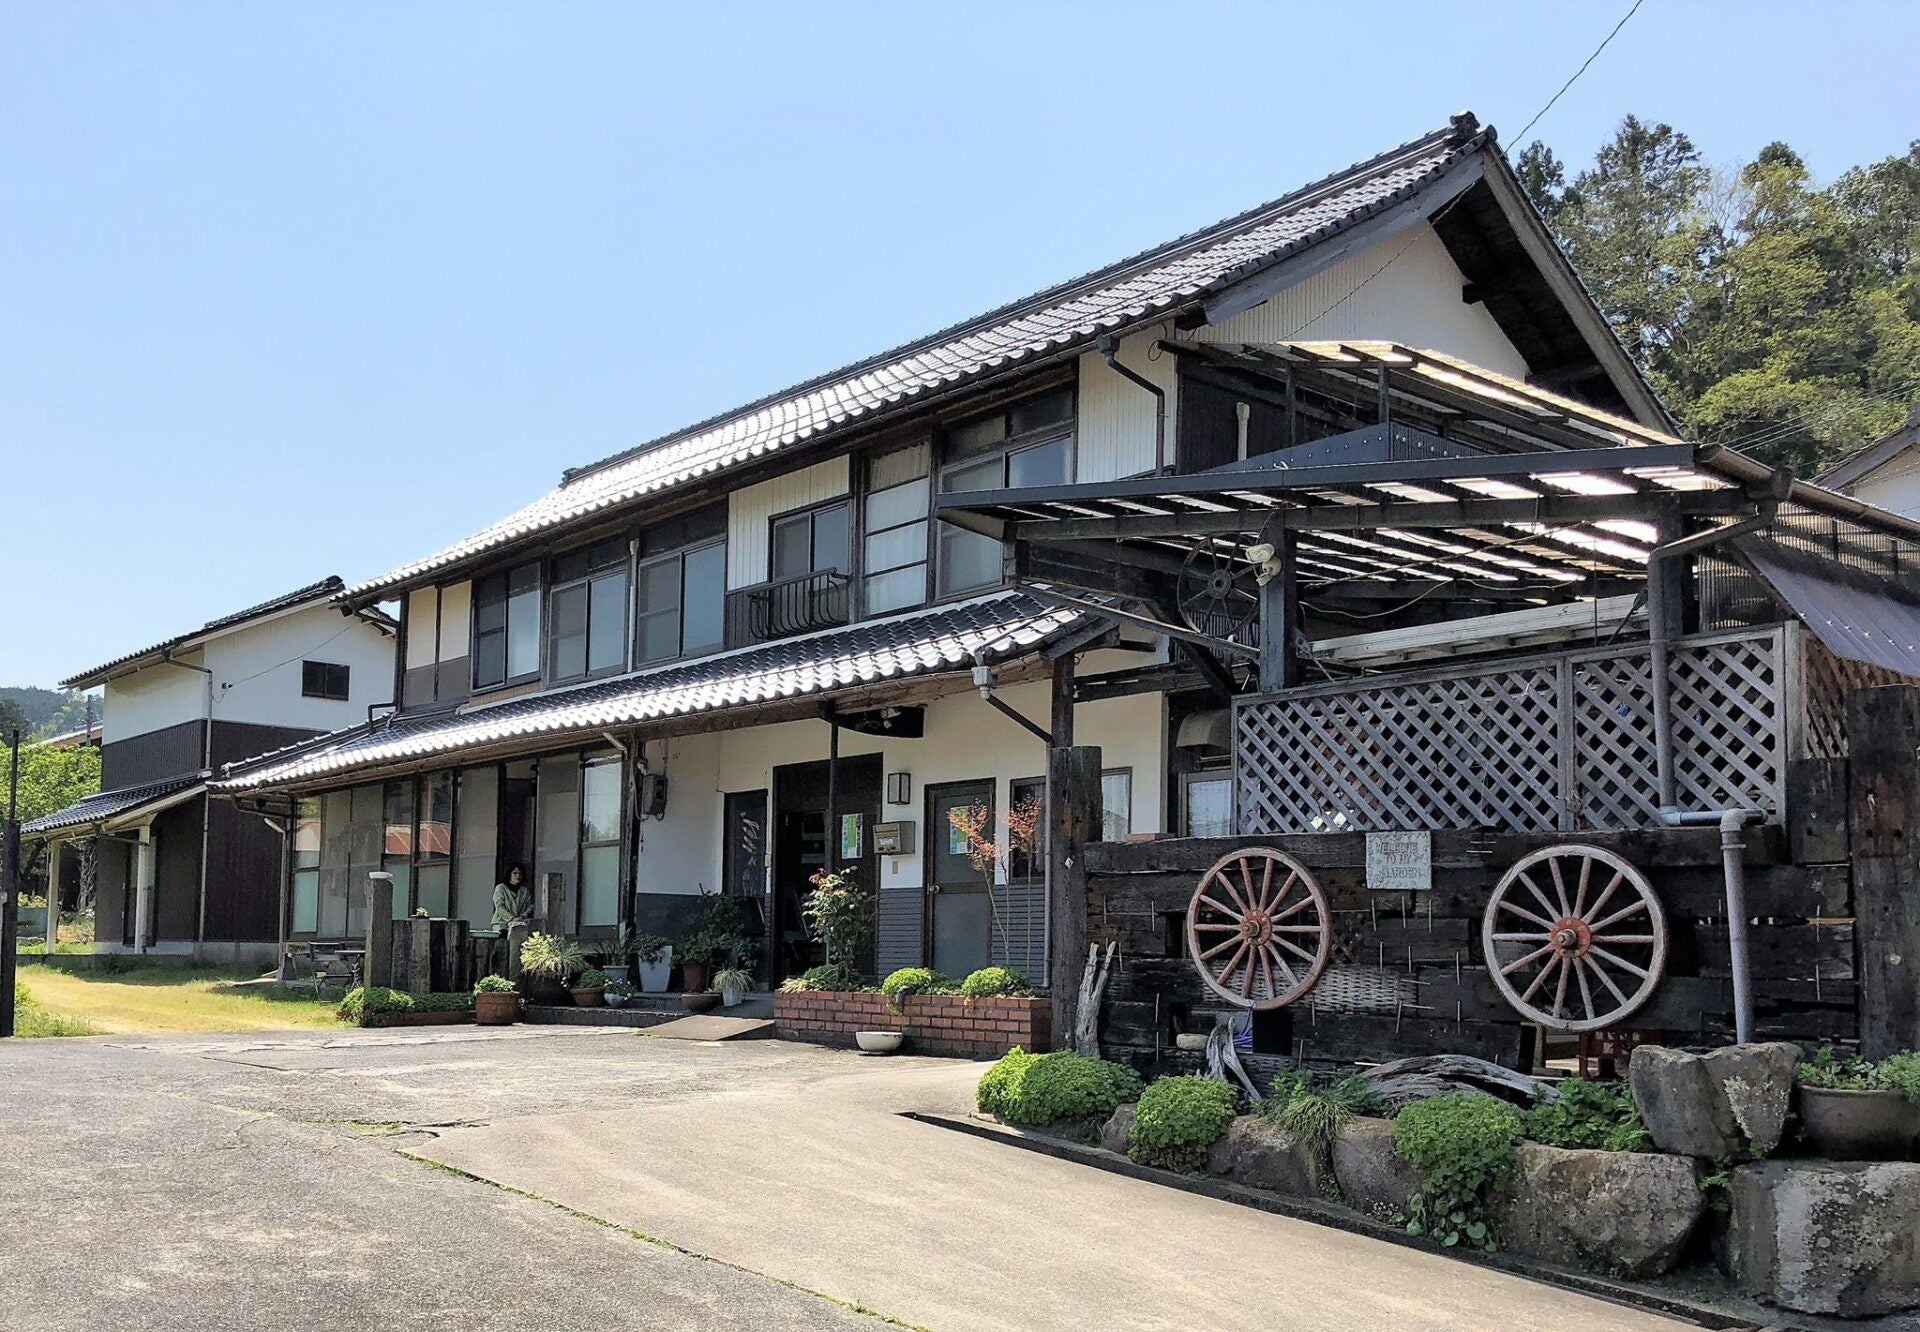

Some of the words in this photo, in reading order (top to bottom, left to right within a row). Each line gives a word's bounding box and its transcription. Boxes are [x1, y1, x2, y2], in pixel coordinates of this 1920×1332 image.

[1375, 842, 1418, 854] WELCOME
[1383, 853, 1396, 864] TO
[1399, 853, 1412, 864] MY
[1382, 866, 1421, 878] GARDEN
